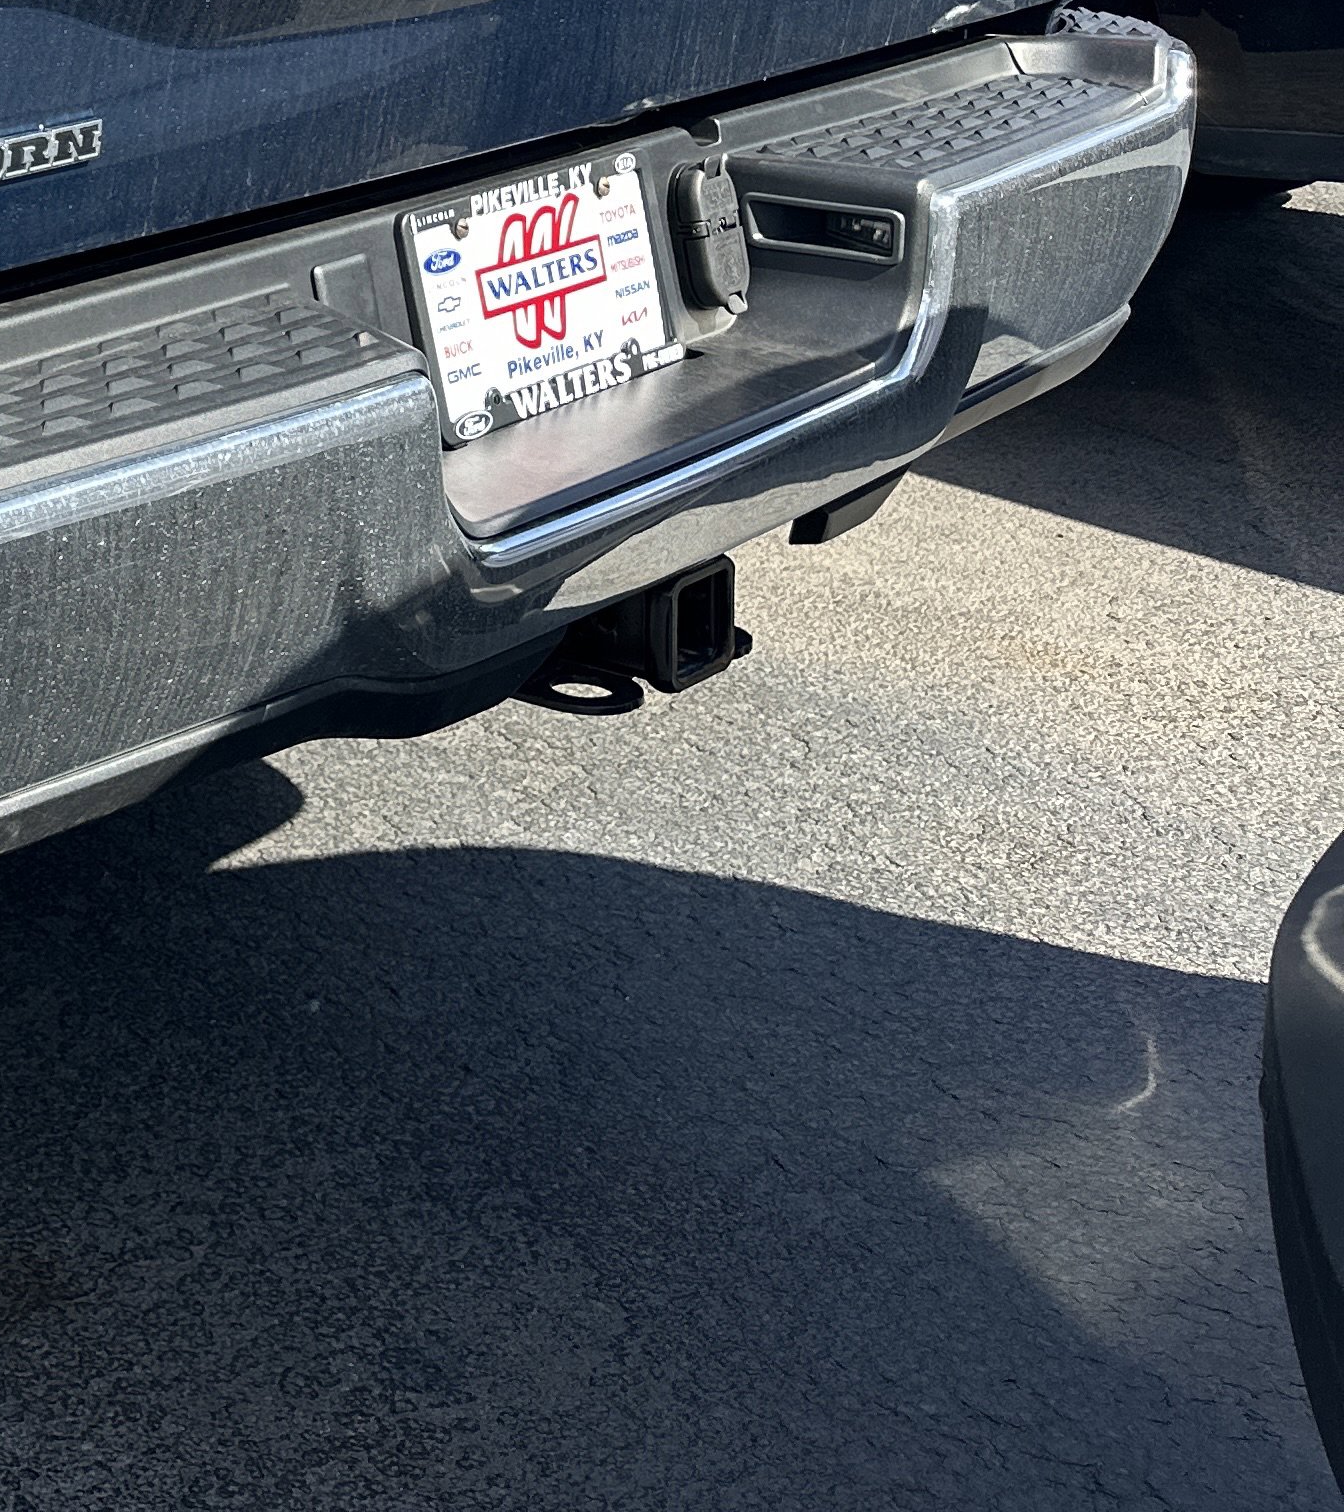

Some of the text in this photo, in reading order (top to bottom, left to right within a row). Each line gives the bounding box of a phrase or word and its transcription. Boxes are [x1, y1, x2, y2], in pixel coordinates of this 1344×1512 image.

[470, 162, 592, 216] PIKEVILLE, KY
[600, 204, 636, 223] TOYOTA
[429, 251, 458, 271] Ford
[487, 249, 598, 300] WALTERS
[615, 280, 650, 298] NISSAN
[444, 340, 473, 358] BUICK
[507, 330, 603, 379] Pikeville, KY
[447, 363, 482, 384] GMC
[510, 352, 632, 419] WALTERS
